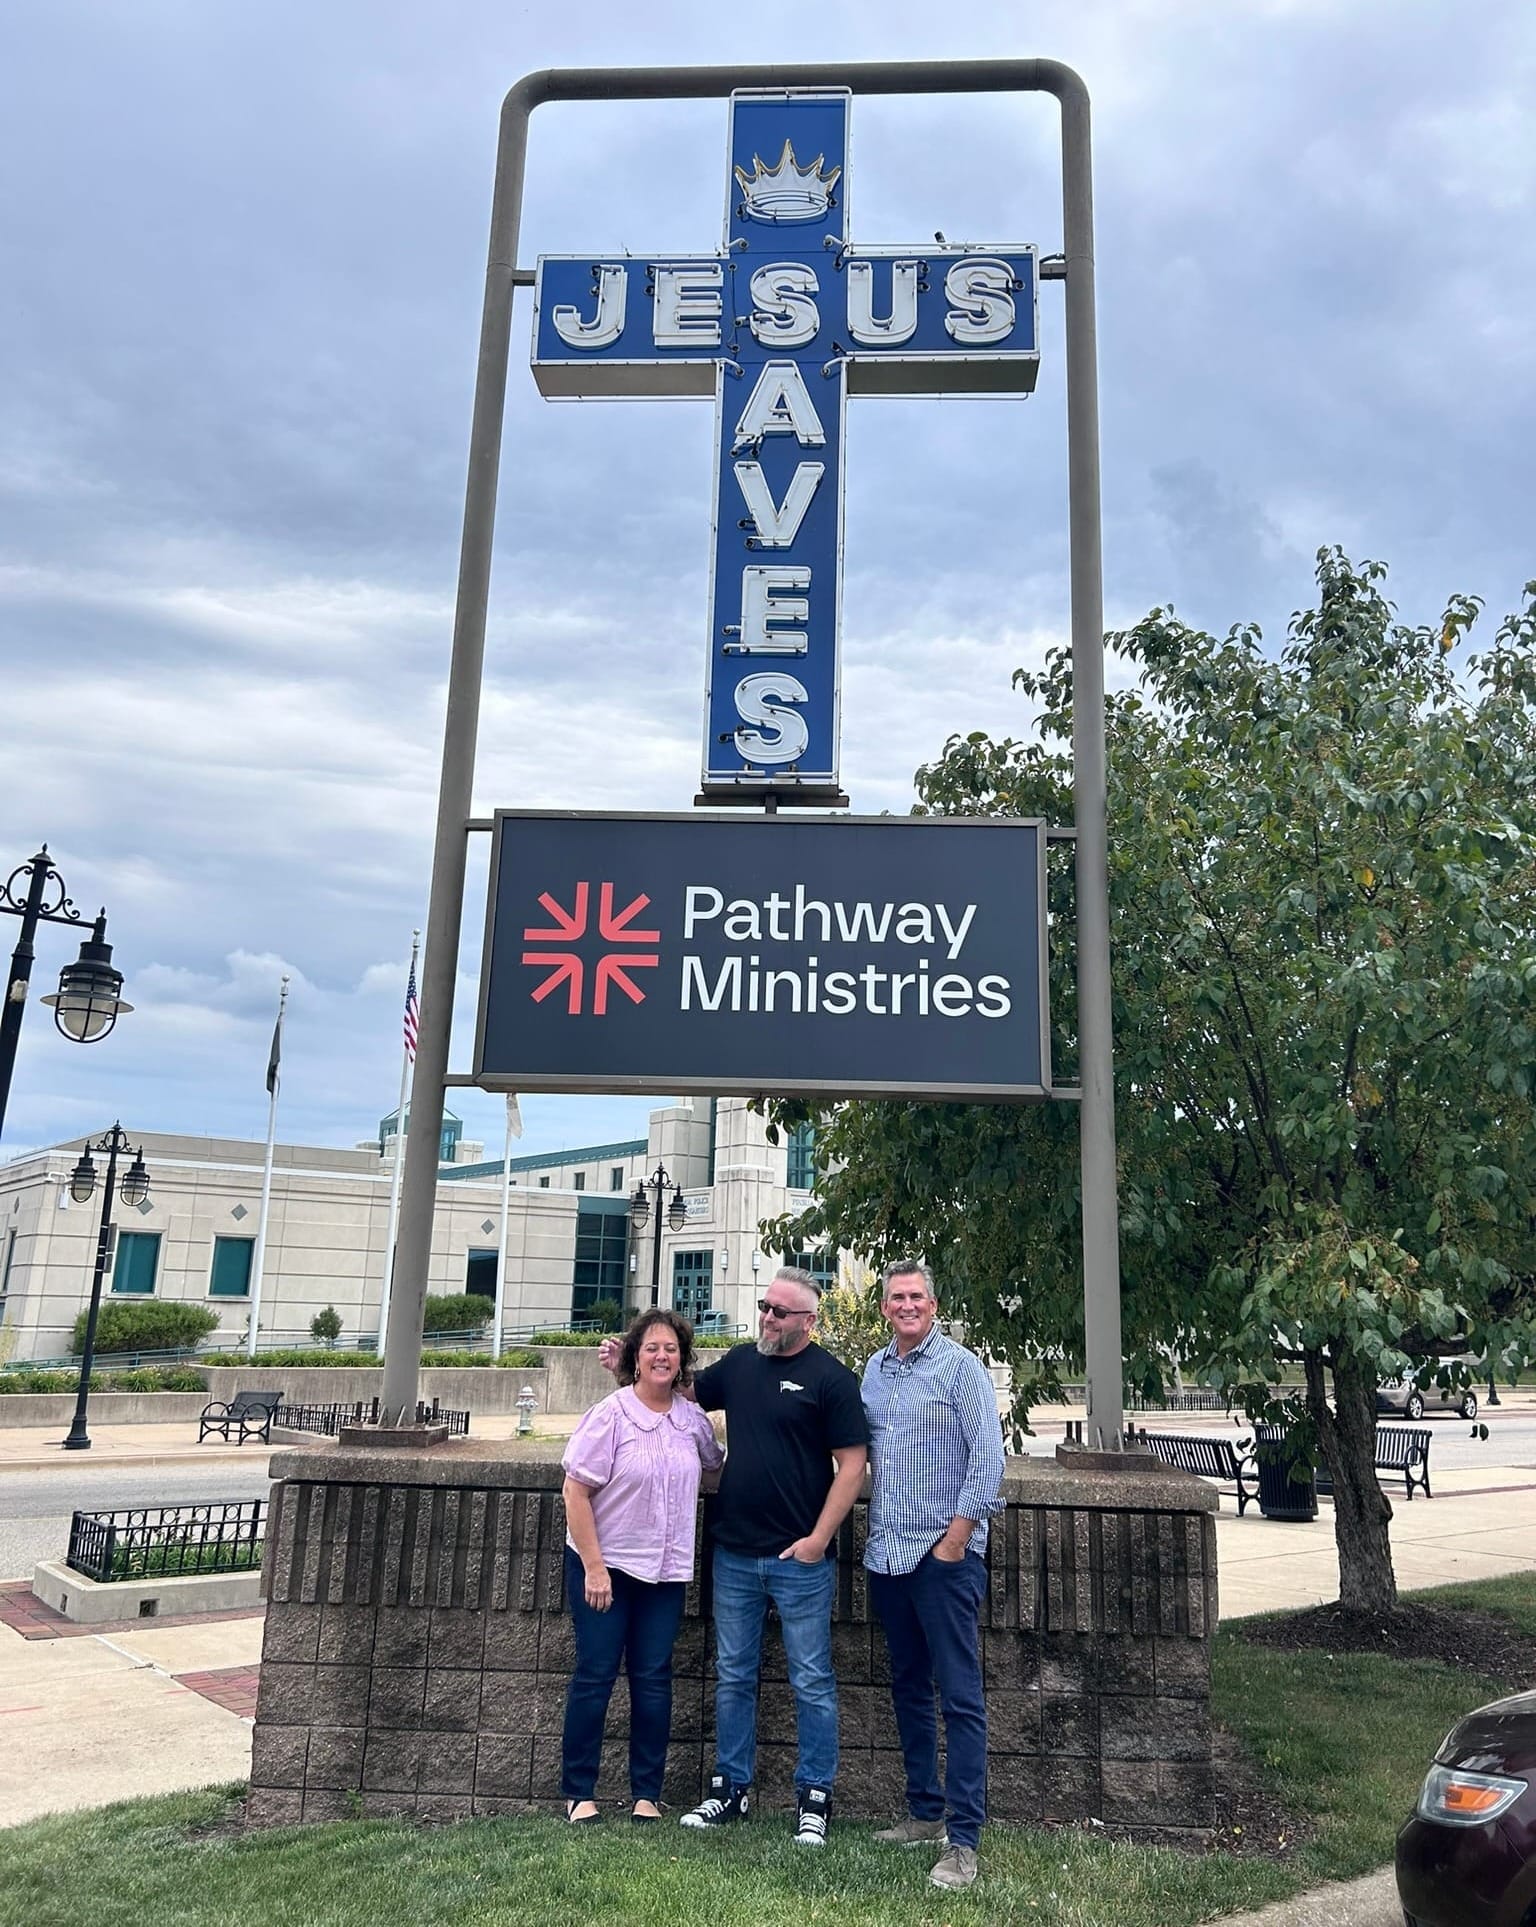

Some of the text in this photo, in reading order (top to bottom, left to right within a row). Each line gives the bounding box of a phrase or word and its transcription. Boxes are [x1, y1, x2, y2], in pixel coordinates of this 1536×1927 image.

[552, 257, 1017, 348] JESUS
[682, 884, 977, 960] Pathway
[680, 955, 1012, 1018] Ministries
